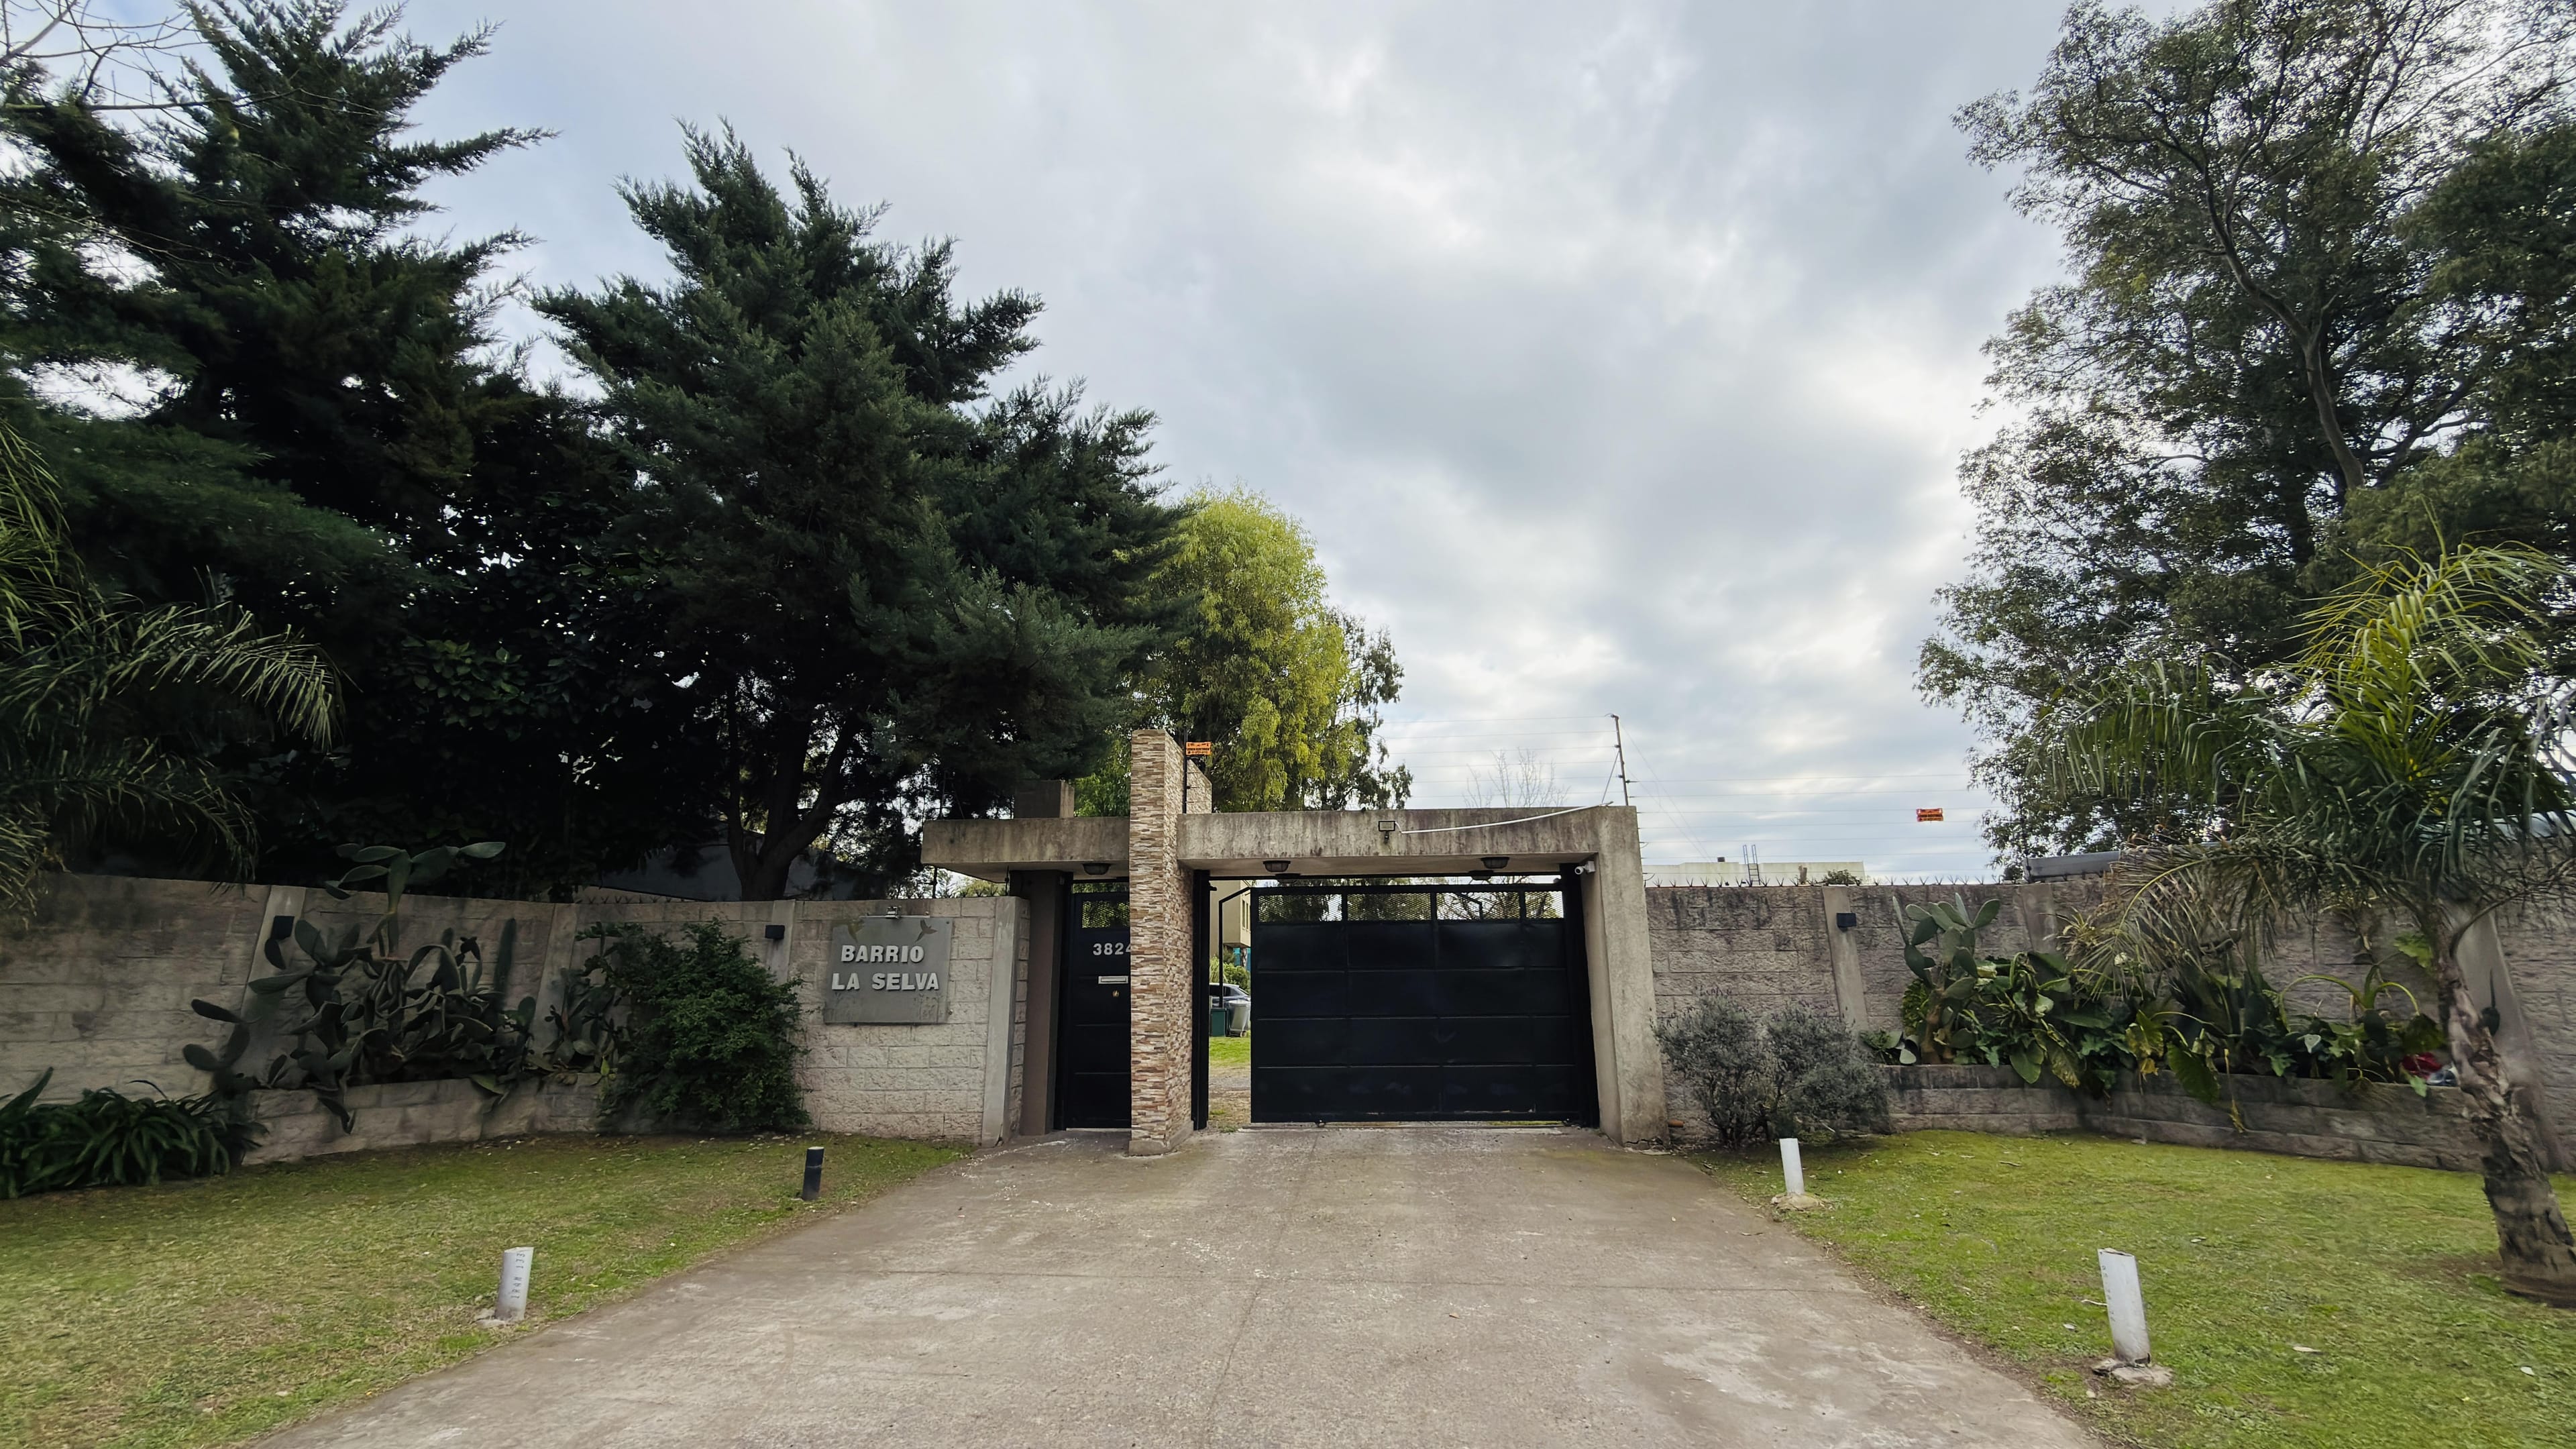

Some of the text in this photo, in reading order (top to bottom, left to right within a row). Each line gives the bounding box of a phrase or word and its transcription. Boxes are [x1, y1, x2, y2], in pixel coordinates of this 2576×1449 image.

[841, 945, 924, 963] BARRIO
[832, 973, 939, 991] LA SELVA
